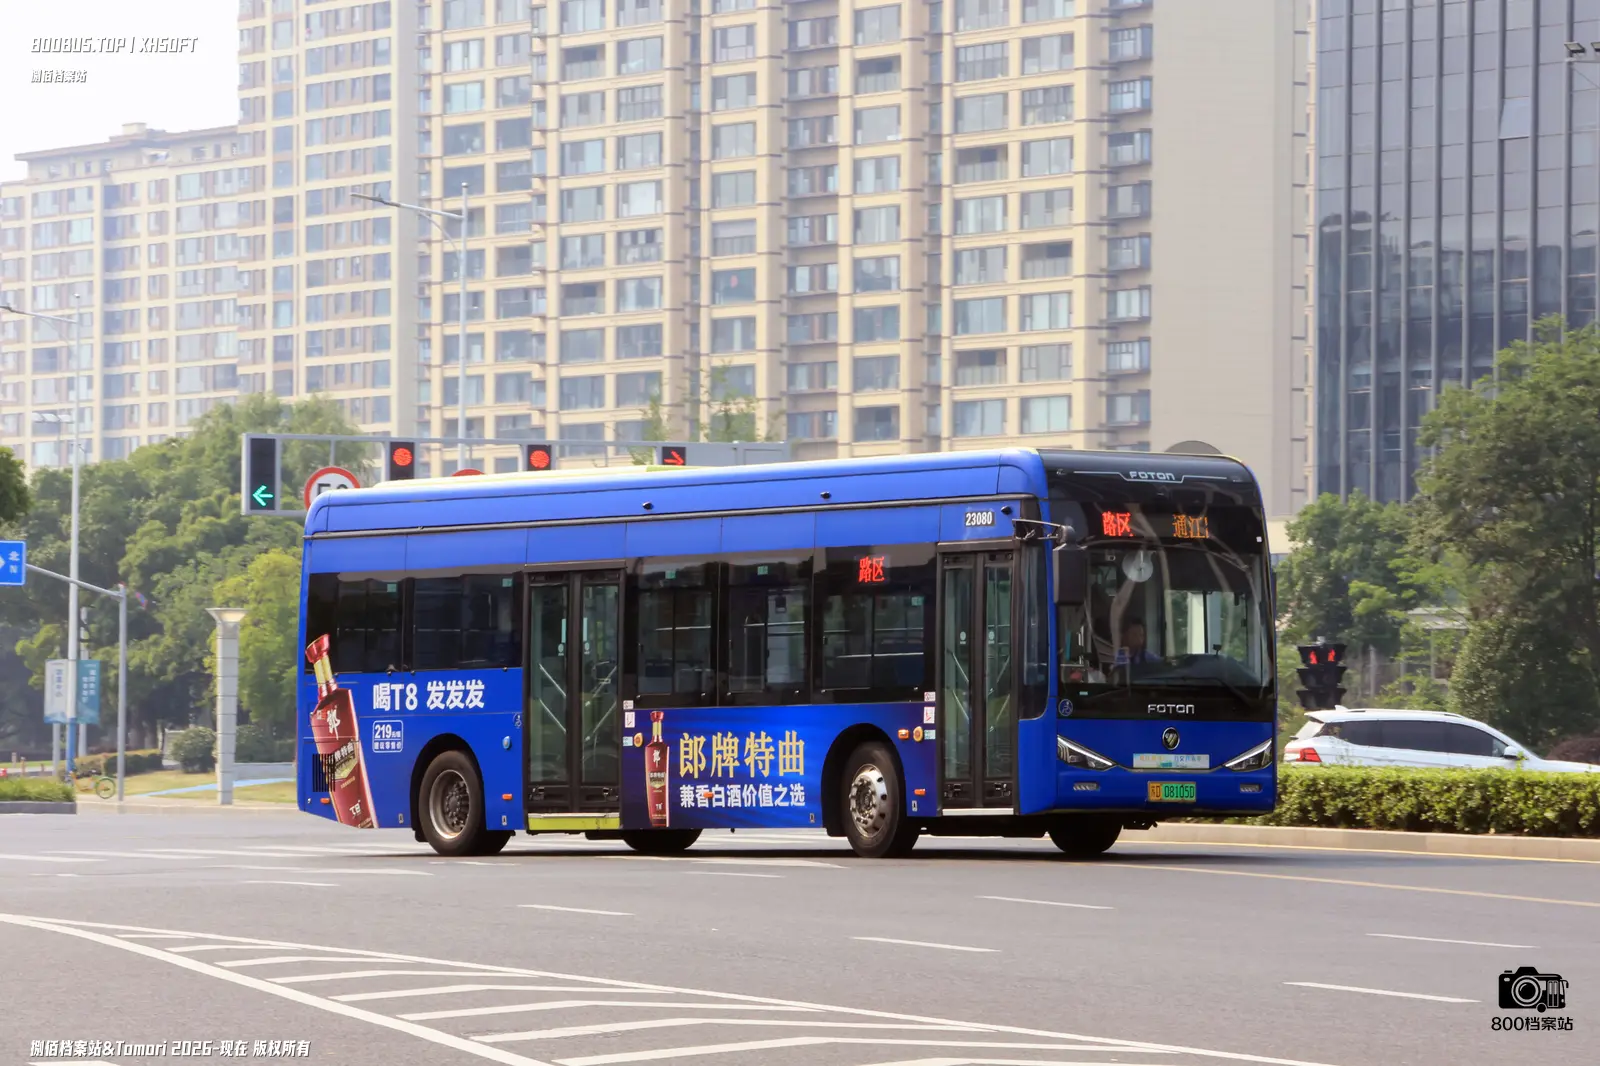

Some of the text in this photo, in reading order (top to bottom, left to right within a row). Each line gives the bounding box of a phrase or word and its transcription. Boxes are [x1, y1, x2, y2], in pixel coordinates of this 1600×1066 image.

[1129, 471, 1175, 480] FOTON
[965, 511, 993, 526] 23080
[373, 679, 485, 711] 喝T8 发发发
[1147, 704, 1195, 714] FOTON
[680, 730, 805, 779] 郎牌特曲
[680, 782, 806, 808] 兼香白酒价值之选
